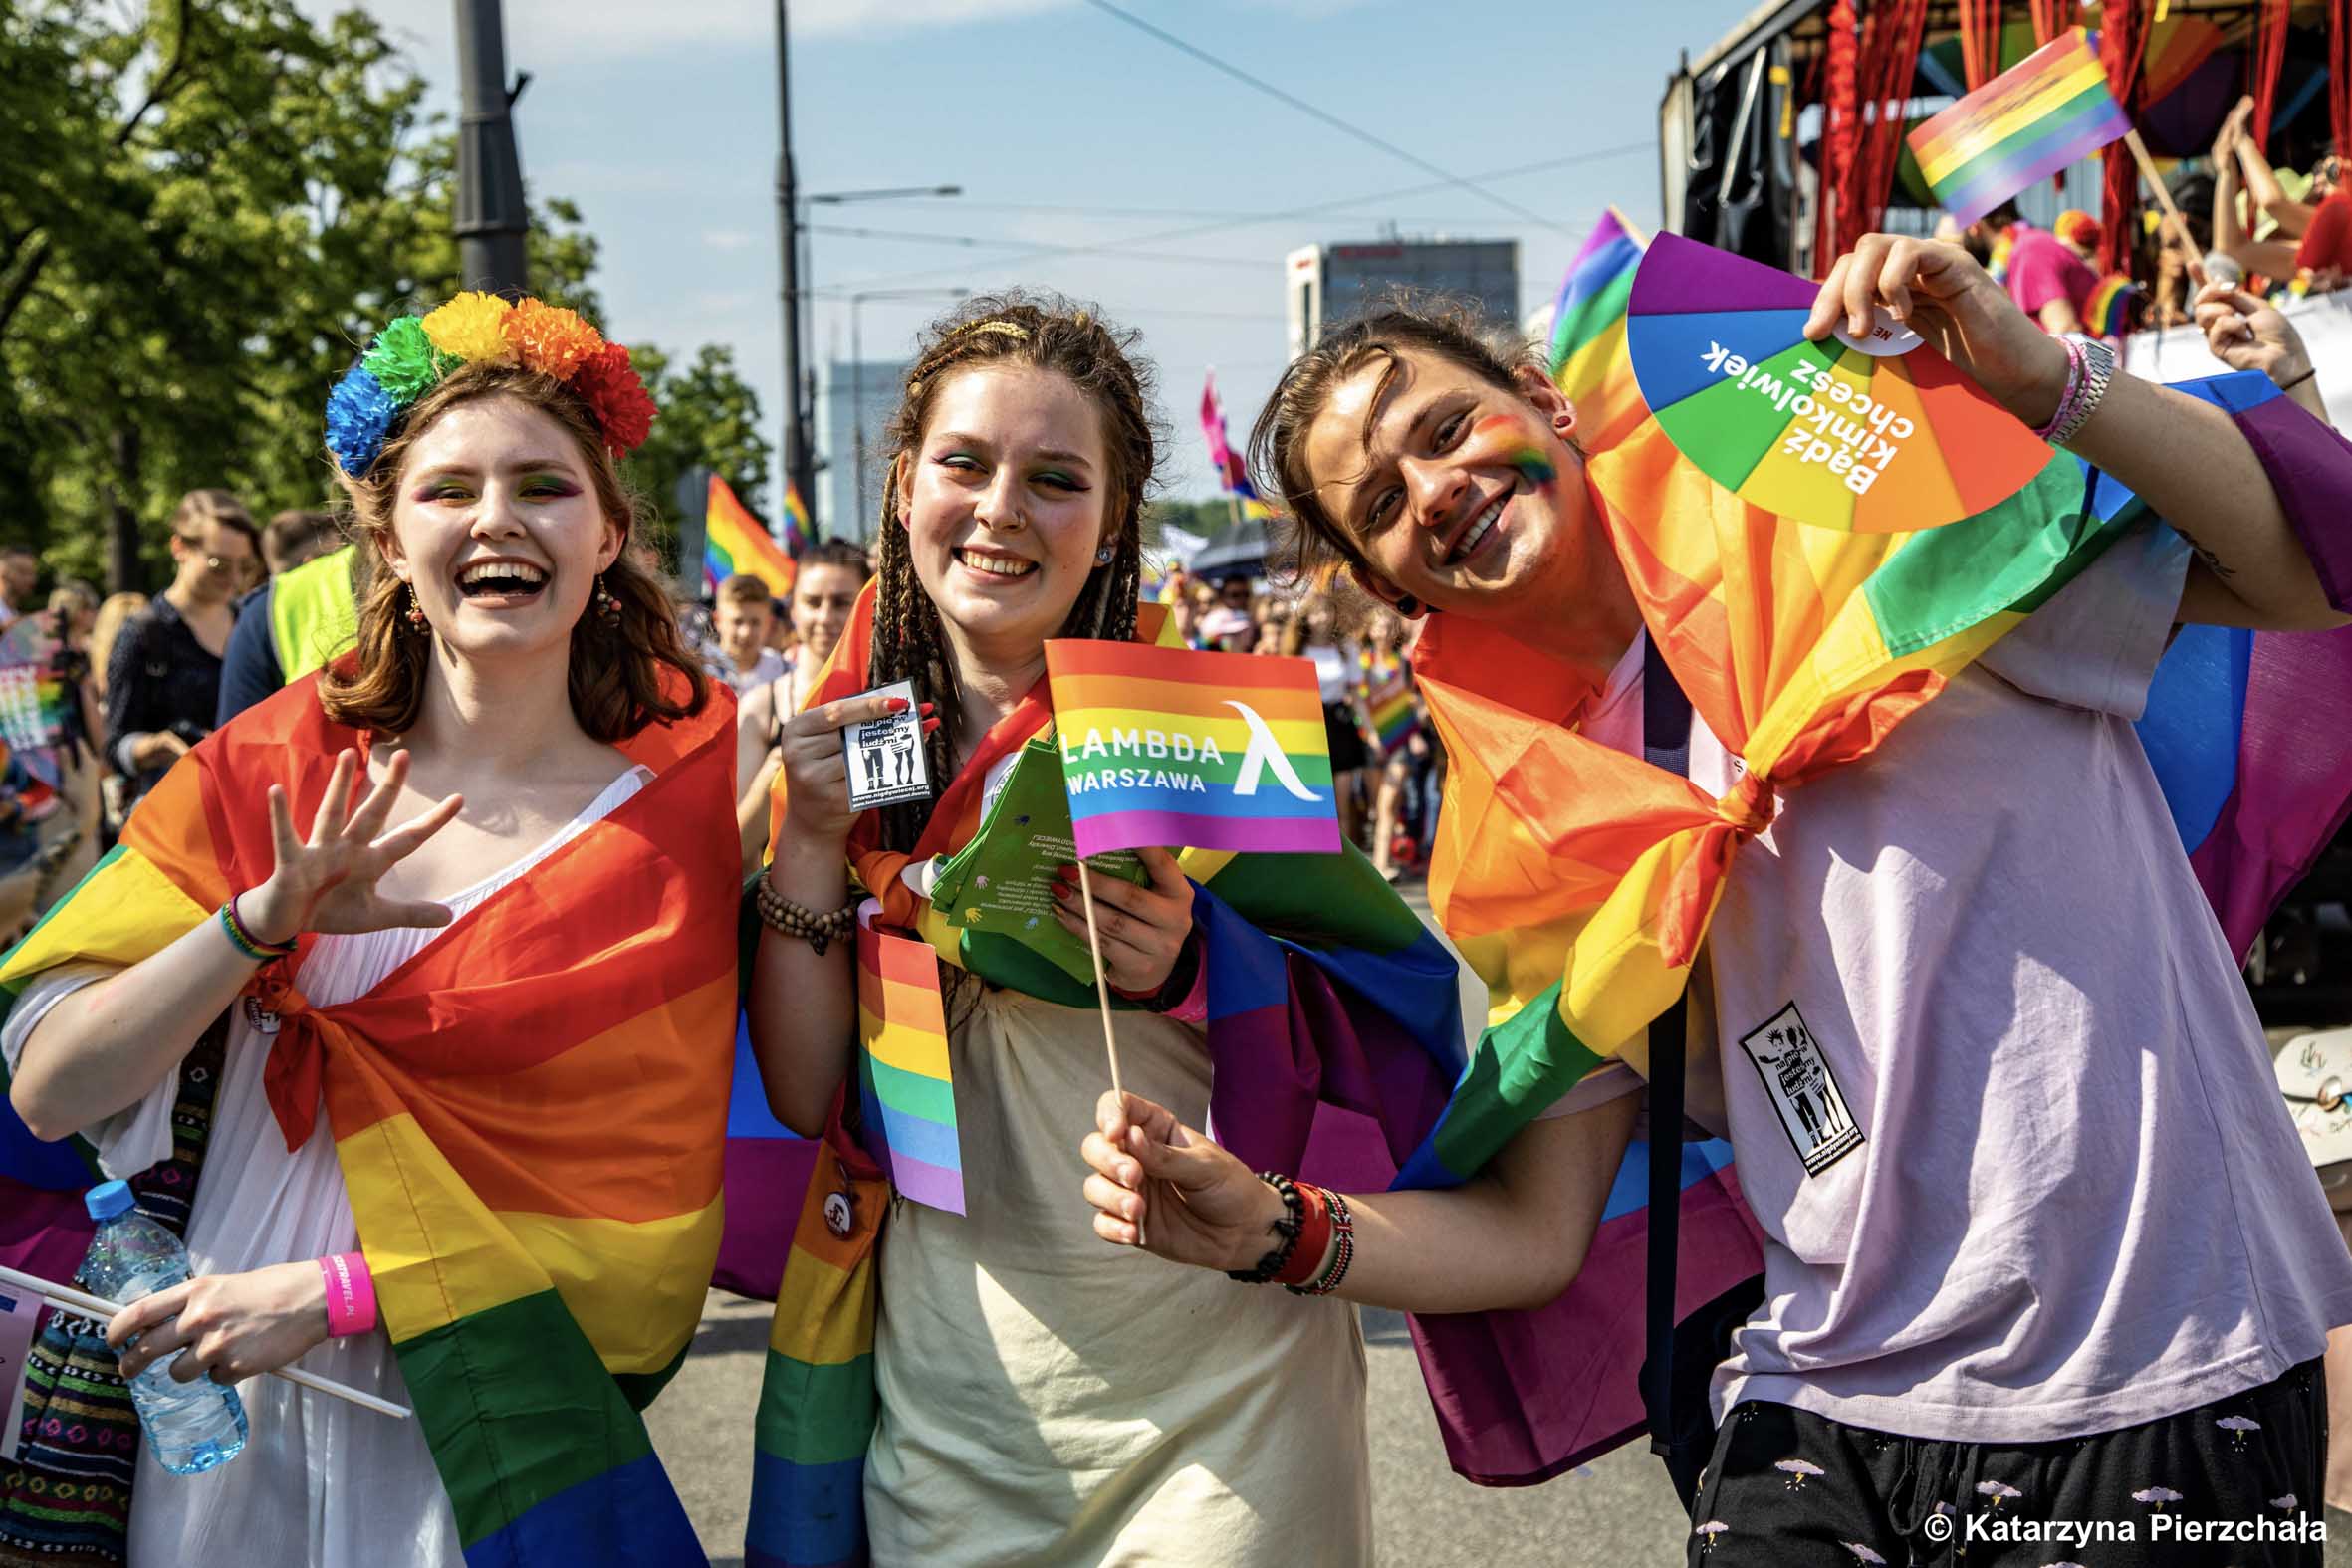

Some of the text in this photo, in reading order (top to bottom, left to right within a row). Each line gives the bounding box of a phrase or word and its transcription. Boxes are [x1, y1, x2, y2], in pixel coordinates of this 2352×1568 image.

[1700, 340, 1898, 471] kimkolwiek
[1790, 359, 1914, 439] chcesz
[1783, 427, 1879, 495] Bądź
[861, 725, 910, 739] jesteśmy
[862, 737, 898, 748] ludźmi
[1061, 727, 1225, 765] LAMBDA
[1067, 768, 1207, 795] WARSZAWA
